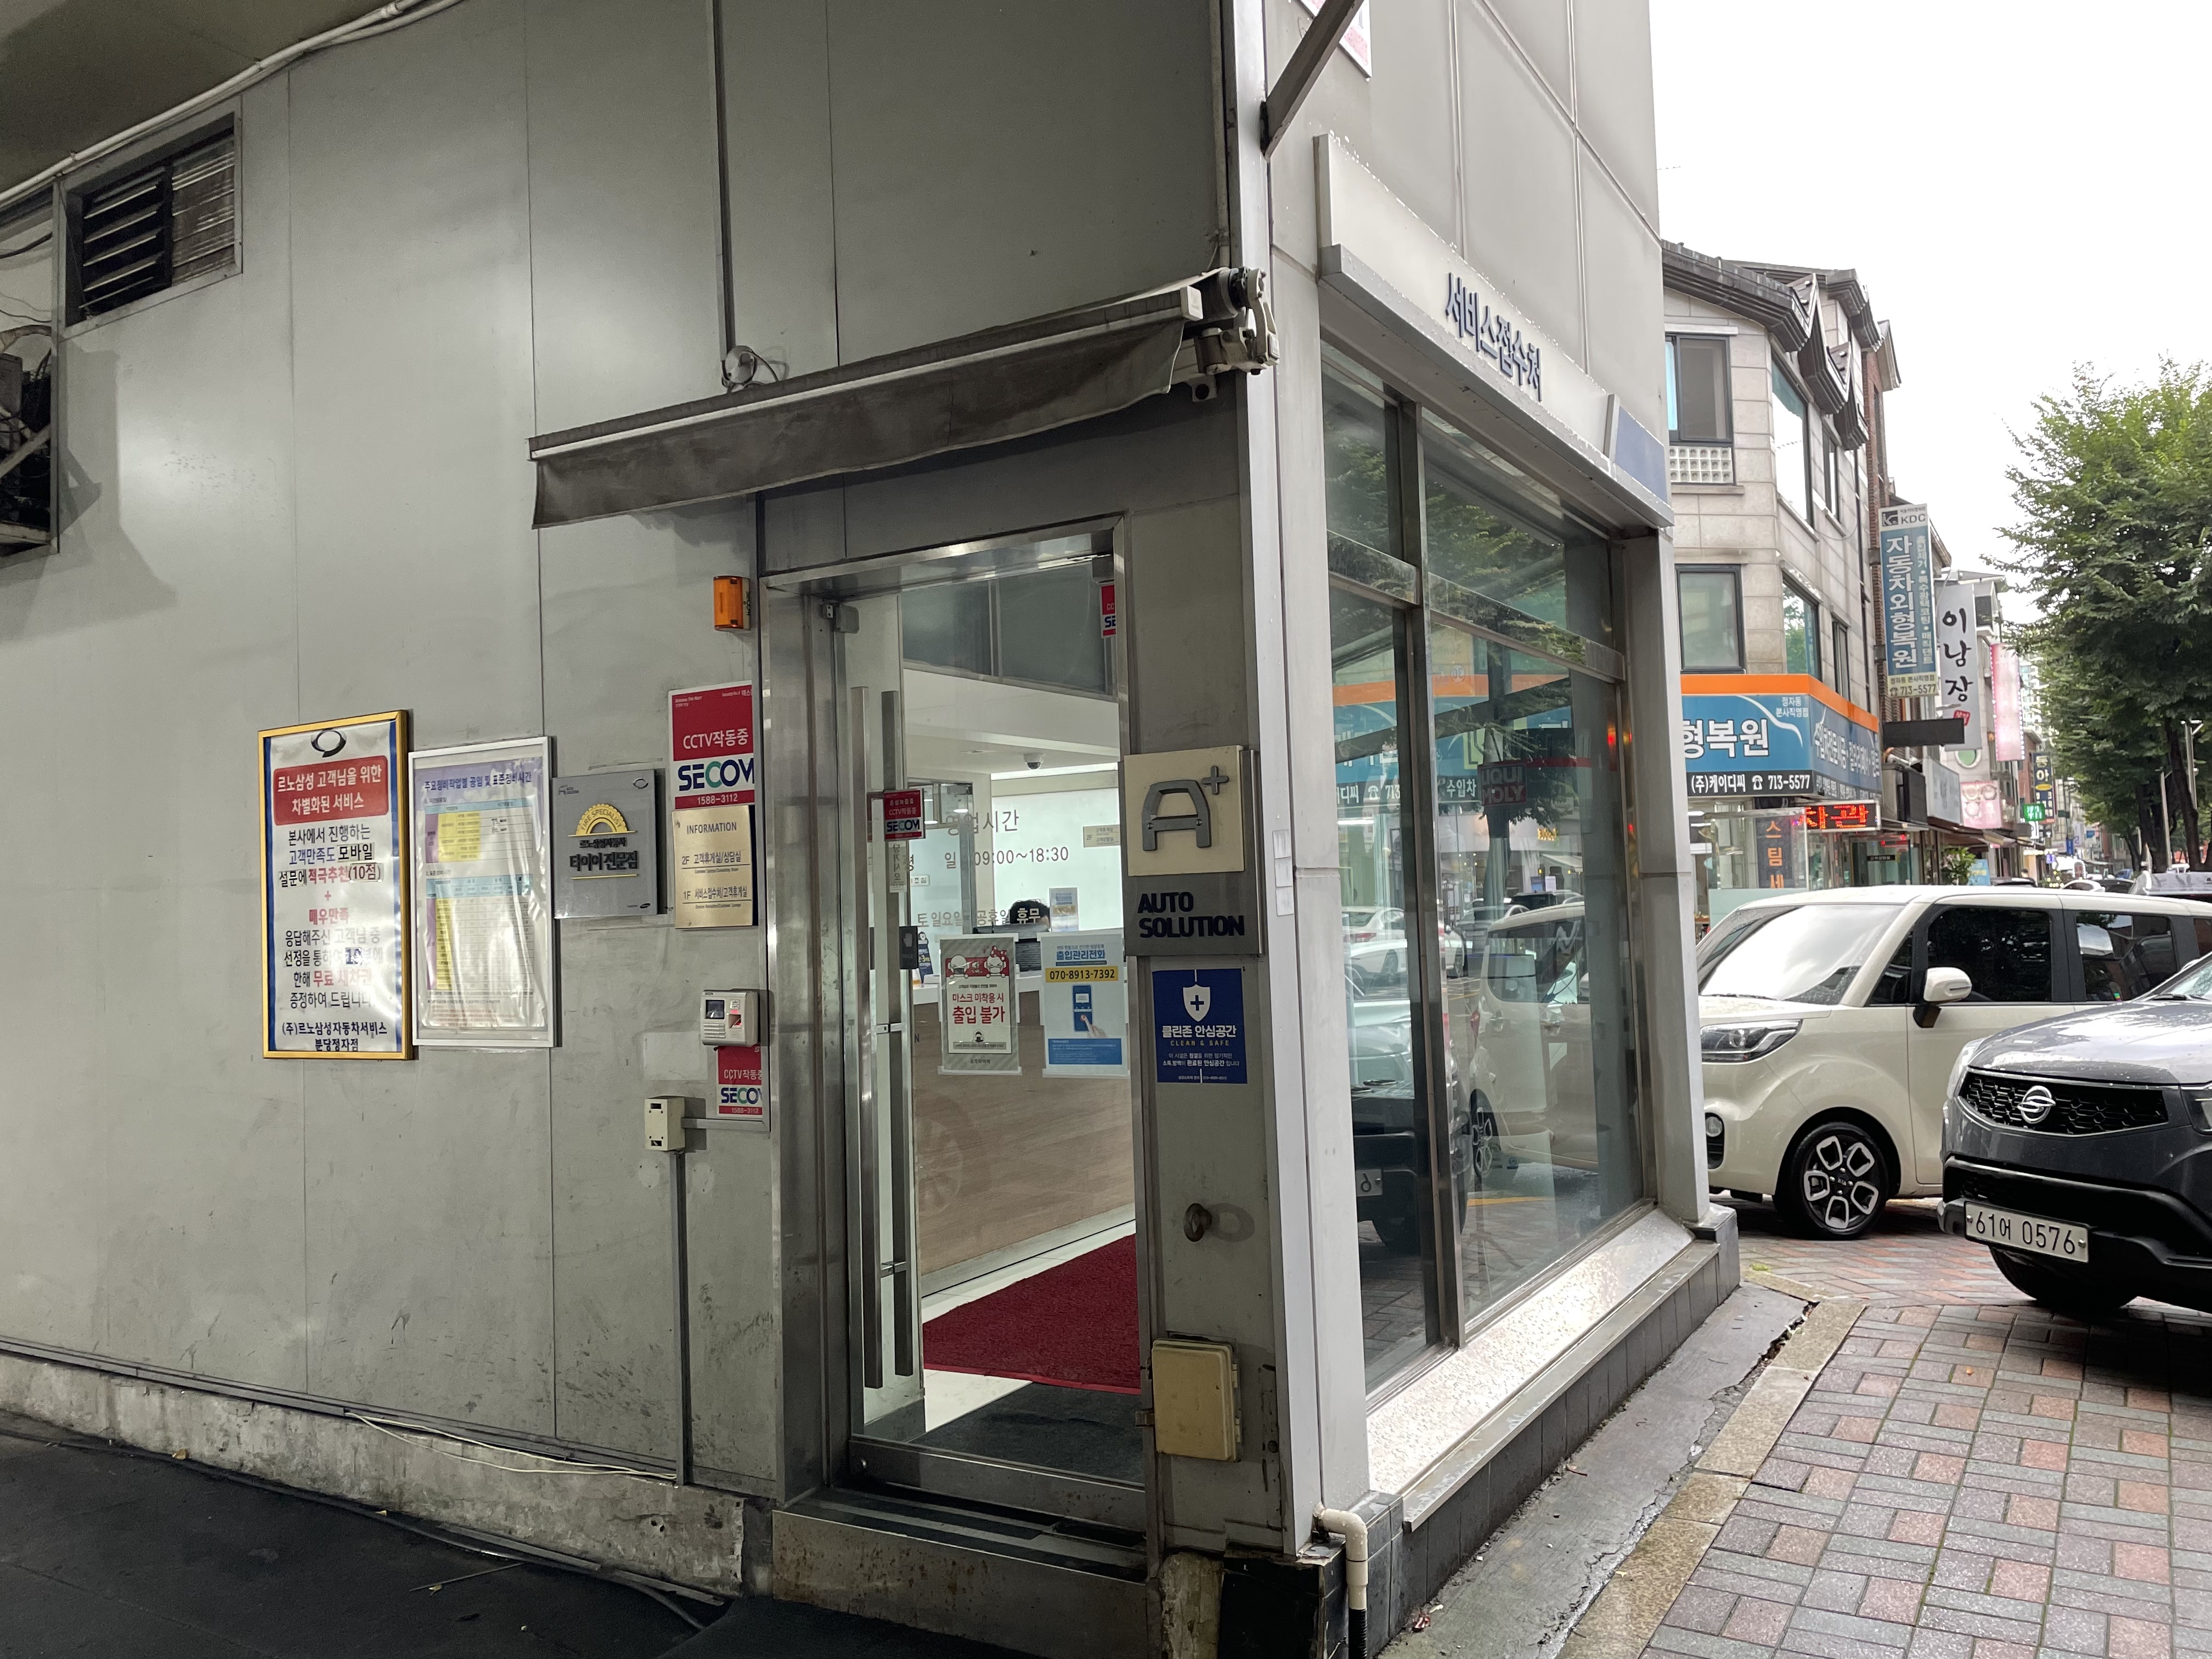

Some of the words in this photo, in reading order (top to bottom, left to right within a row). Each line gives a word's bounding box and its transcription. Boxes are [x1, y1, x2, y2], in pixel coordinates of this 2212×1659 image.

[1445, 272, 1543, 402] 서비스접수처
[1901, 514, 1926, 524] KDC
[1886, 535, 1918, 669] 자동차외형복원
[1942, 608, 1973, 702] 이남장
[1900, 684, 1936, 695] 713-5577
[1782, 697, 1802, 707] 정자동
[1776, 708, 1809, 718] 본사직영점
[683, 728, 749, 749] CCTV작동중
[1682, 718, 1769, 759] 형복원
[278, 772, 314, 792] 르노삼성
[317, 767, 357, 787] 고객님을
[359, 764, 382, 783] 위한
[470, 776, 483, 788] 공임
[678, 758, 754, 791] SECOM
[1482, 766, 1523, 785] LIQUI
[1447, 778, 1476, 798] 수입차
[1691, 774, 1746, 794] (주)케이디씨
[1768, 775, 1810, 791] 713-5577
[292, 796, 330, 815] 차별화된
[333, 792, 364, 810] 서비스
[698, 793, 737, 805] 1588-3112
[1482, 785, 1525, 804] MOLY
[580, 815, 592, 831] TIRE
[591, 809, 623, 828] SPECIALIST
[889, 807, 917, 816] CCTV작동중
[687, 822, 736, 834] INFORMATION
[887, 819, 919, 832] SECOM
[946, 809, 1019, 836] 영업시간
[289, 827, 325, 846] 본사에서
[328, 823, 370, 842] 진행하는
[579, 837, 627, 849] 르노삼성자동차
[289, 847, 335, 865] 고객만족도
[338, 843, 373, 860] 모바일
[682, 856, 690, 865] 2F
[694, 850, 741, 864] 고객휴게실/상담실
[974, 847, 1068, 866] 09:00~18:30
[279, 869, 307, 888] 설문에
[684, 891, 691, 900] 1F
[1137, 891, 1194, 914] AUTO
[309, 907, 349, 925] 매우만족
[977, 909, 1011, 927] 공휴일
[1017, 907, 1041, 924] 휴무
[1139, 915, 1245, 938] SOLUTION
[285, 929, 330, 947] 응답해주신
[335, 927, 366, 944] 고객님
[284, 950, 311, 967] 선정을
[1057, 950, 1105, 960] 출입관리전화
[294, 971, 311, 988] 한해
[313, 970, 334, 988] 무료
[1050, 969, 1115, 980] 070-8913-7392
[290, 992, 327, 1009] 증정하여
[952, 994, 974, 1003] 마스크
[975, 993, 996, 1003] 미착용
[997, 992, 1004, 1003] 시
[952, 1007, 976, 1024] 출입
[980, 1006, 1005, 1024] 불가
[282, 1022, 387, 1036] (주)르노삼성자동차서비스
[1162, 1025, 1192, 1038] 클린존
[1195, 1025, 1237, 1038] 안심공간
[315, 1039, 358, 1052] 분당정자점
[1976, 1212, 2011, 1240] 61어
[2022, 1221, 2075, 1254] 0576
